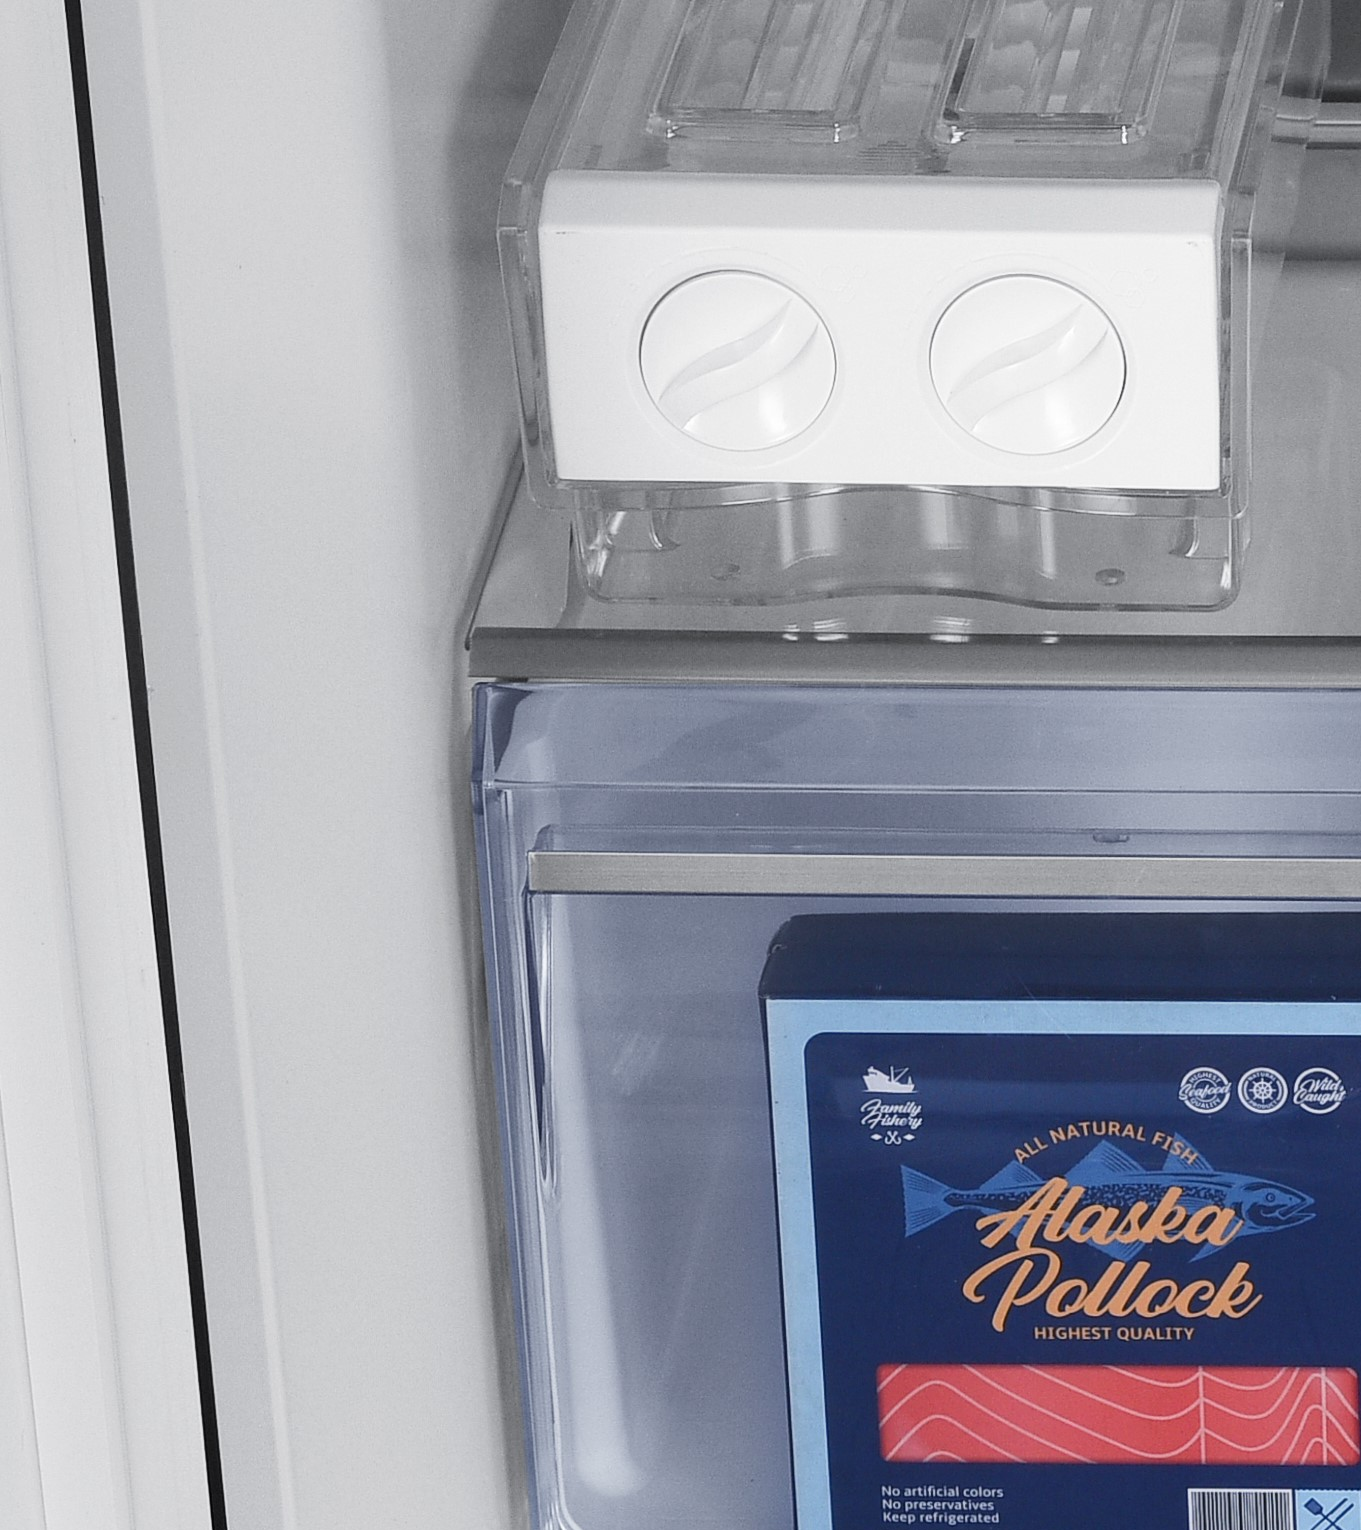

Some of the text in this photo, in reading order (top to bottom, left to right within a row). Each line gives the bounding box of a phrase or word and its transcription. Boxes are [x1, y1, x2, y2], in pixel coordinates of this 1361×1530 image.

[1189, 1071, 1221, 1083] HIGHEST
[1247, 1072, 1277, 1082] NATURAL
[1178, 1082, 1232, 1101] Seafood
[1293, 1088, 1346, 1105] Caught
[860, 1099, 922, 1117] Family
[1190, 1097, 1221, 1109] QUALITY
[861, 1112, 923, 1130] Fishery
[1014, 1121, 1199, 1165] ALL NATURAL FISH
[975, 1176, 1245, 1250] Alaska
[962, 1247, 1263, 1332] Pollock
[1034, 1327, 1195, 1341] HIGHEST QUALITY
[881, 1485, 1004, 1498] No artificial colors
[882, 1499, 995, 1512] No preservatives
[883, 1512, 1000, 1526] Keep refrigerated
